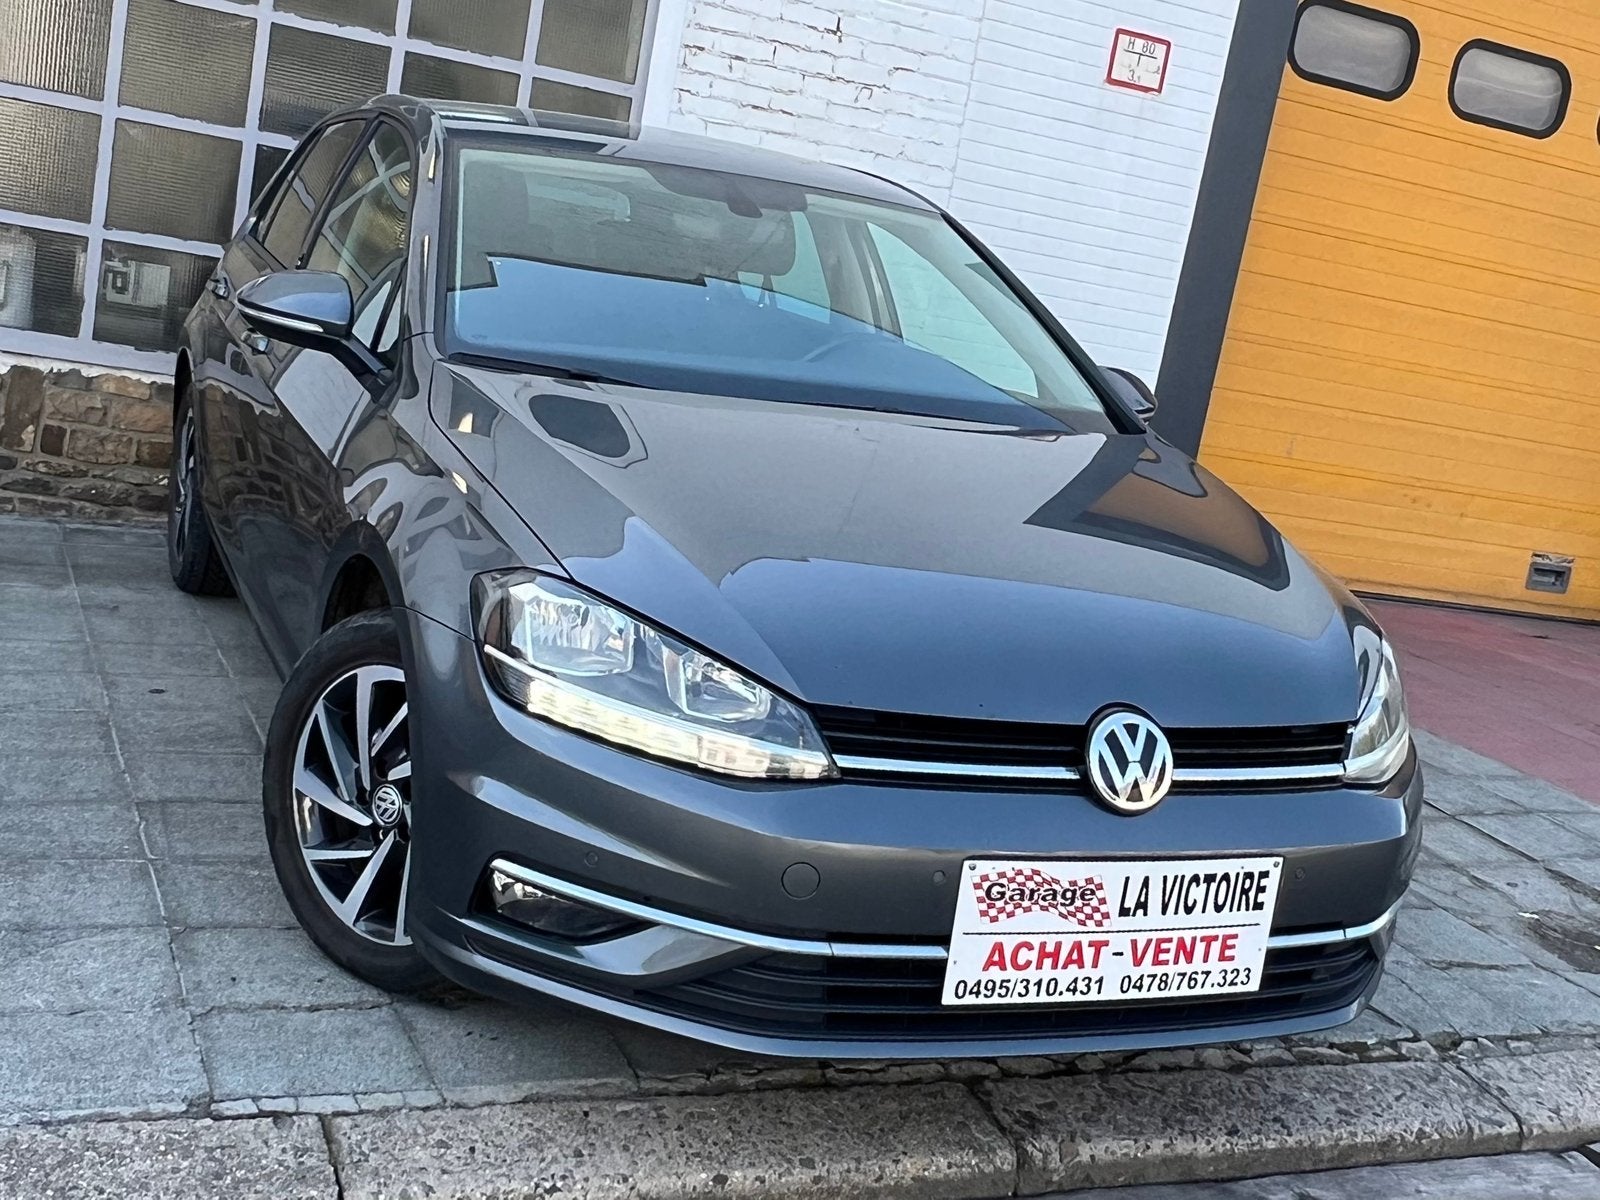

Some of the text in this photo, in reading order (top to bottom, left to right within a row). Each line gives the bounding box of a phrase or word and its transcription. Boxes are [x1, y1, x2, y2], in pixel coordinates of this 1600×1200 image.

[1127, 37, 1156, 55] H 80
[985, 870, 1270, 918] Garage LA VICTOIRE
[954, 967, 1251, 1000] 0495/310.431 0478/767.323
